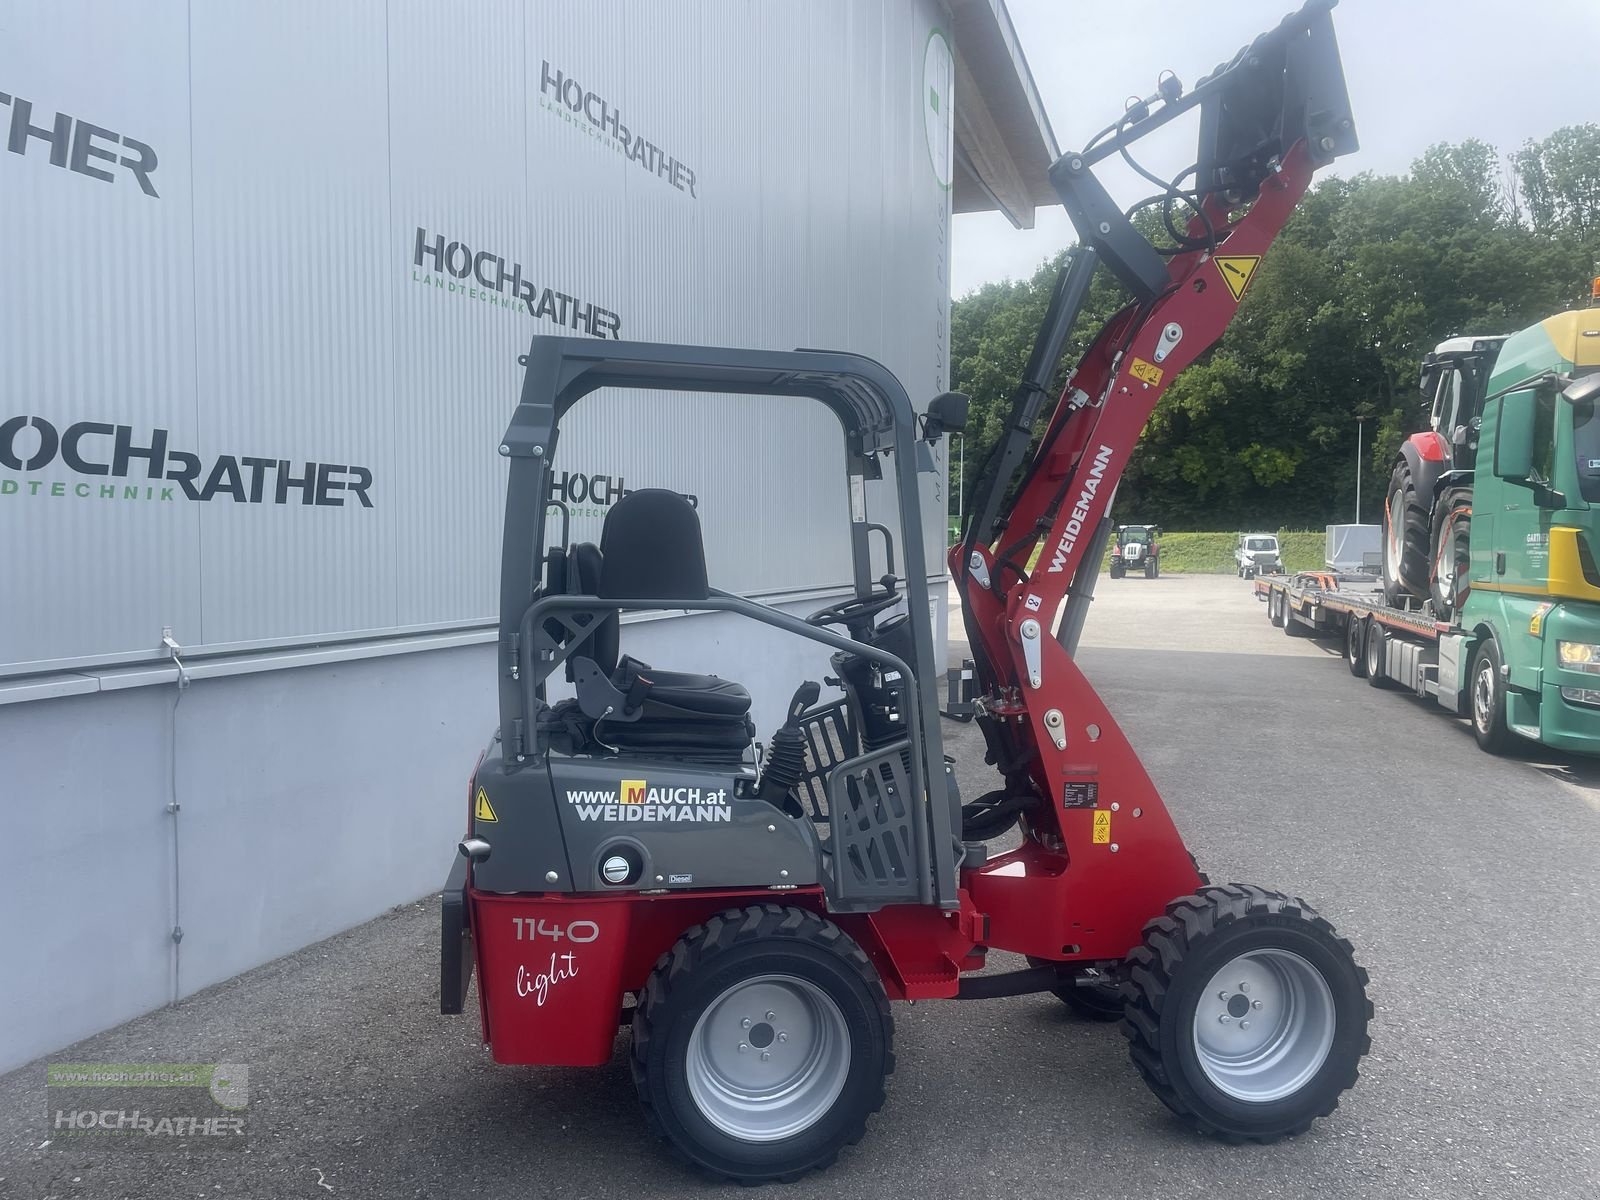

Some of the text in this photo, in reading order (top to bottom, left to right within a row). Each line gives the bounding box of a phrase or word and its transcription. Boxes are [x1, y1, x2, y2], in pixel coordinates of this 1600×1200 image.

[538, 97, 623, 156] LANDTECHNIK
[540, 59, 697, 199] HOCHRATHER
[412, 270, 526, 314] LANDTECHNIK
[414, 226, 621, 340] HOCHRATHER
[1048, 444, 1114, 573] WEIDEMANN
[575, 805, 732, 822] WEIDEMANN
[670, 875, 691, 883] Diesel
[512, 918, 600, 943] 1140
[517, 951, 579, 1007] light
